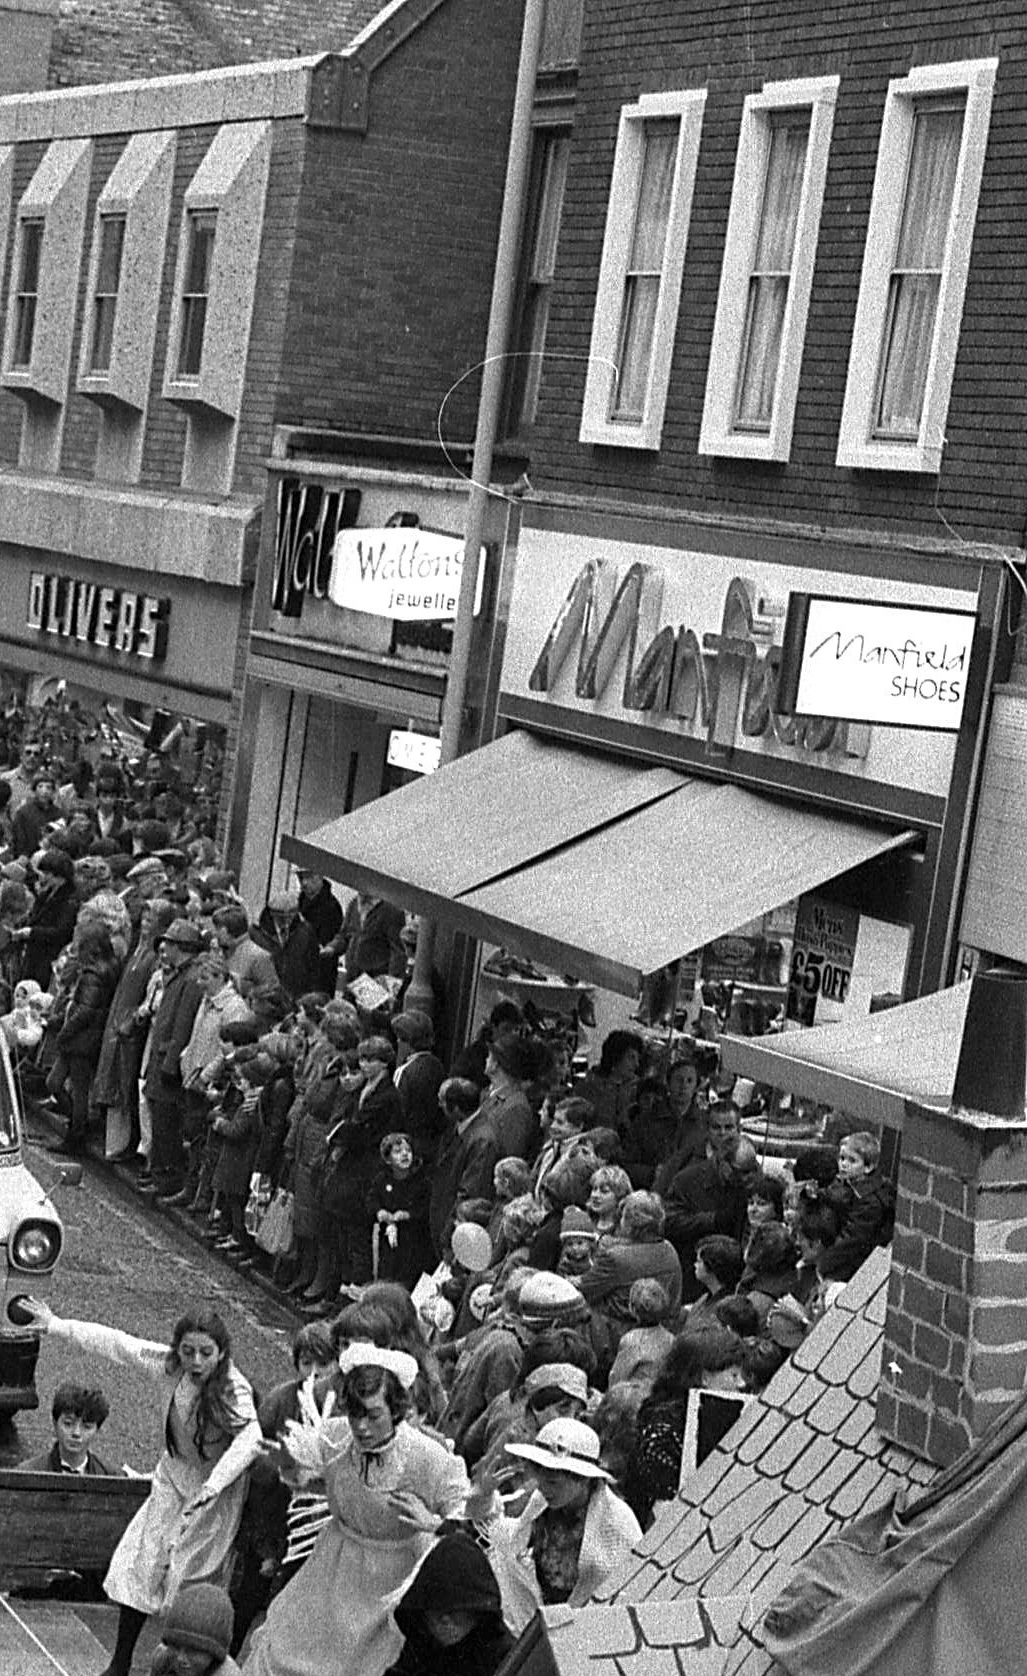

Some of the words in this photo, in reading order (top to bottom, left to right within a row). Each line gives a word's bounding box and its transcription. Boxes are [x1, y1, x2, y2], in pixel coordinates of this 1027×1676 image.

[27, 571, 164, 659] OLIVERS
[388, 589, 456, 612] jewelle
[809, 631, 967, 672] Manfield
[890, 675, 961, 703] SHOES
[822, 962, 852, 1001] OFF
